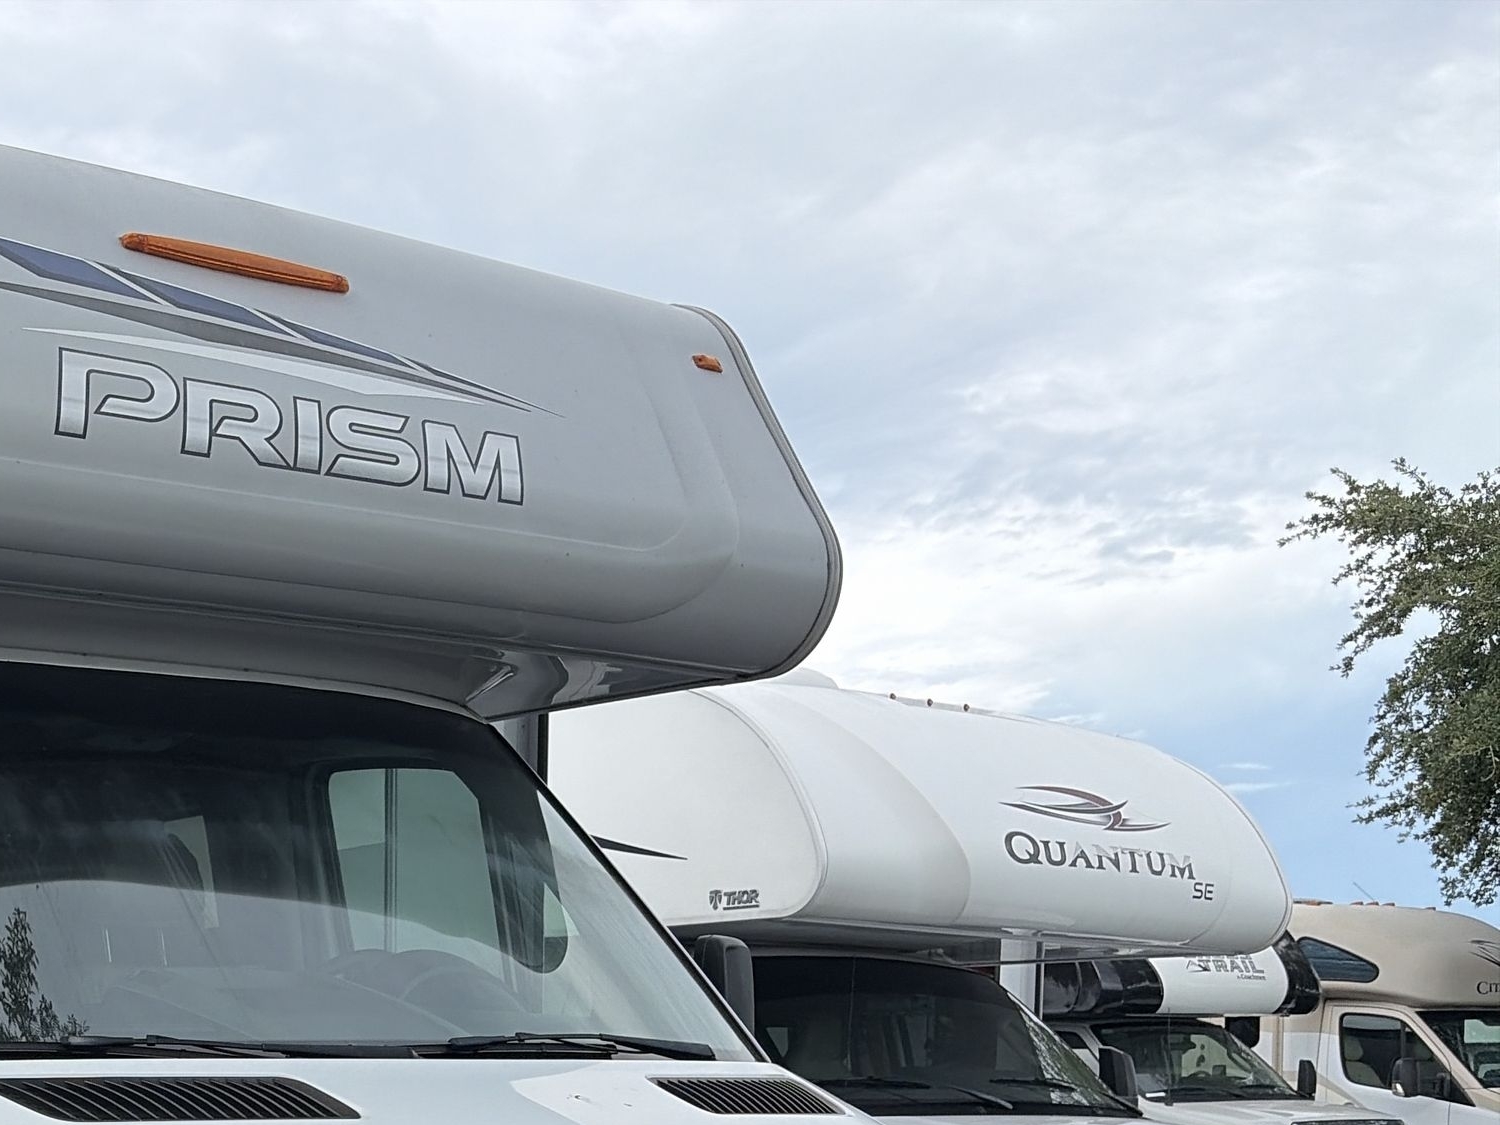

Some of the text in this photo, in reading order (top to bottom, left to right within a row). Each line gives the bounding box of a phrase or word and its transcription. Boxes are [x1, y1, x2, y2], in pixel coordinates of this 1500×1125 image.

[54, 346, 524, 506] PRISM
[1004, 831, 1196, 880] QUANTUM
[722, 889, 760, 906] THOR
[1192, 882, 1214, 900] SE
[1197, 960, 1265, 974] TRAIL
